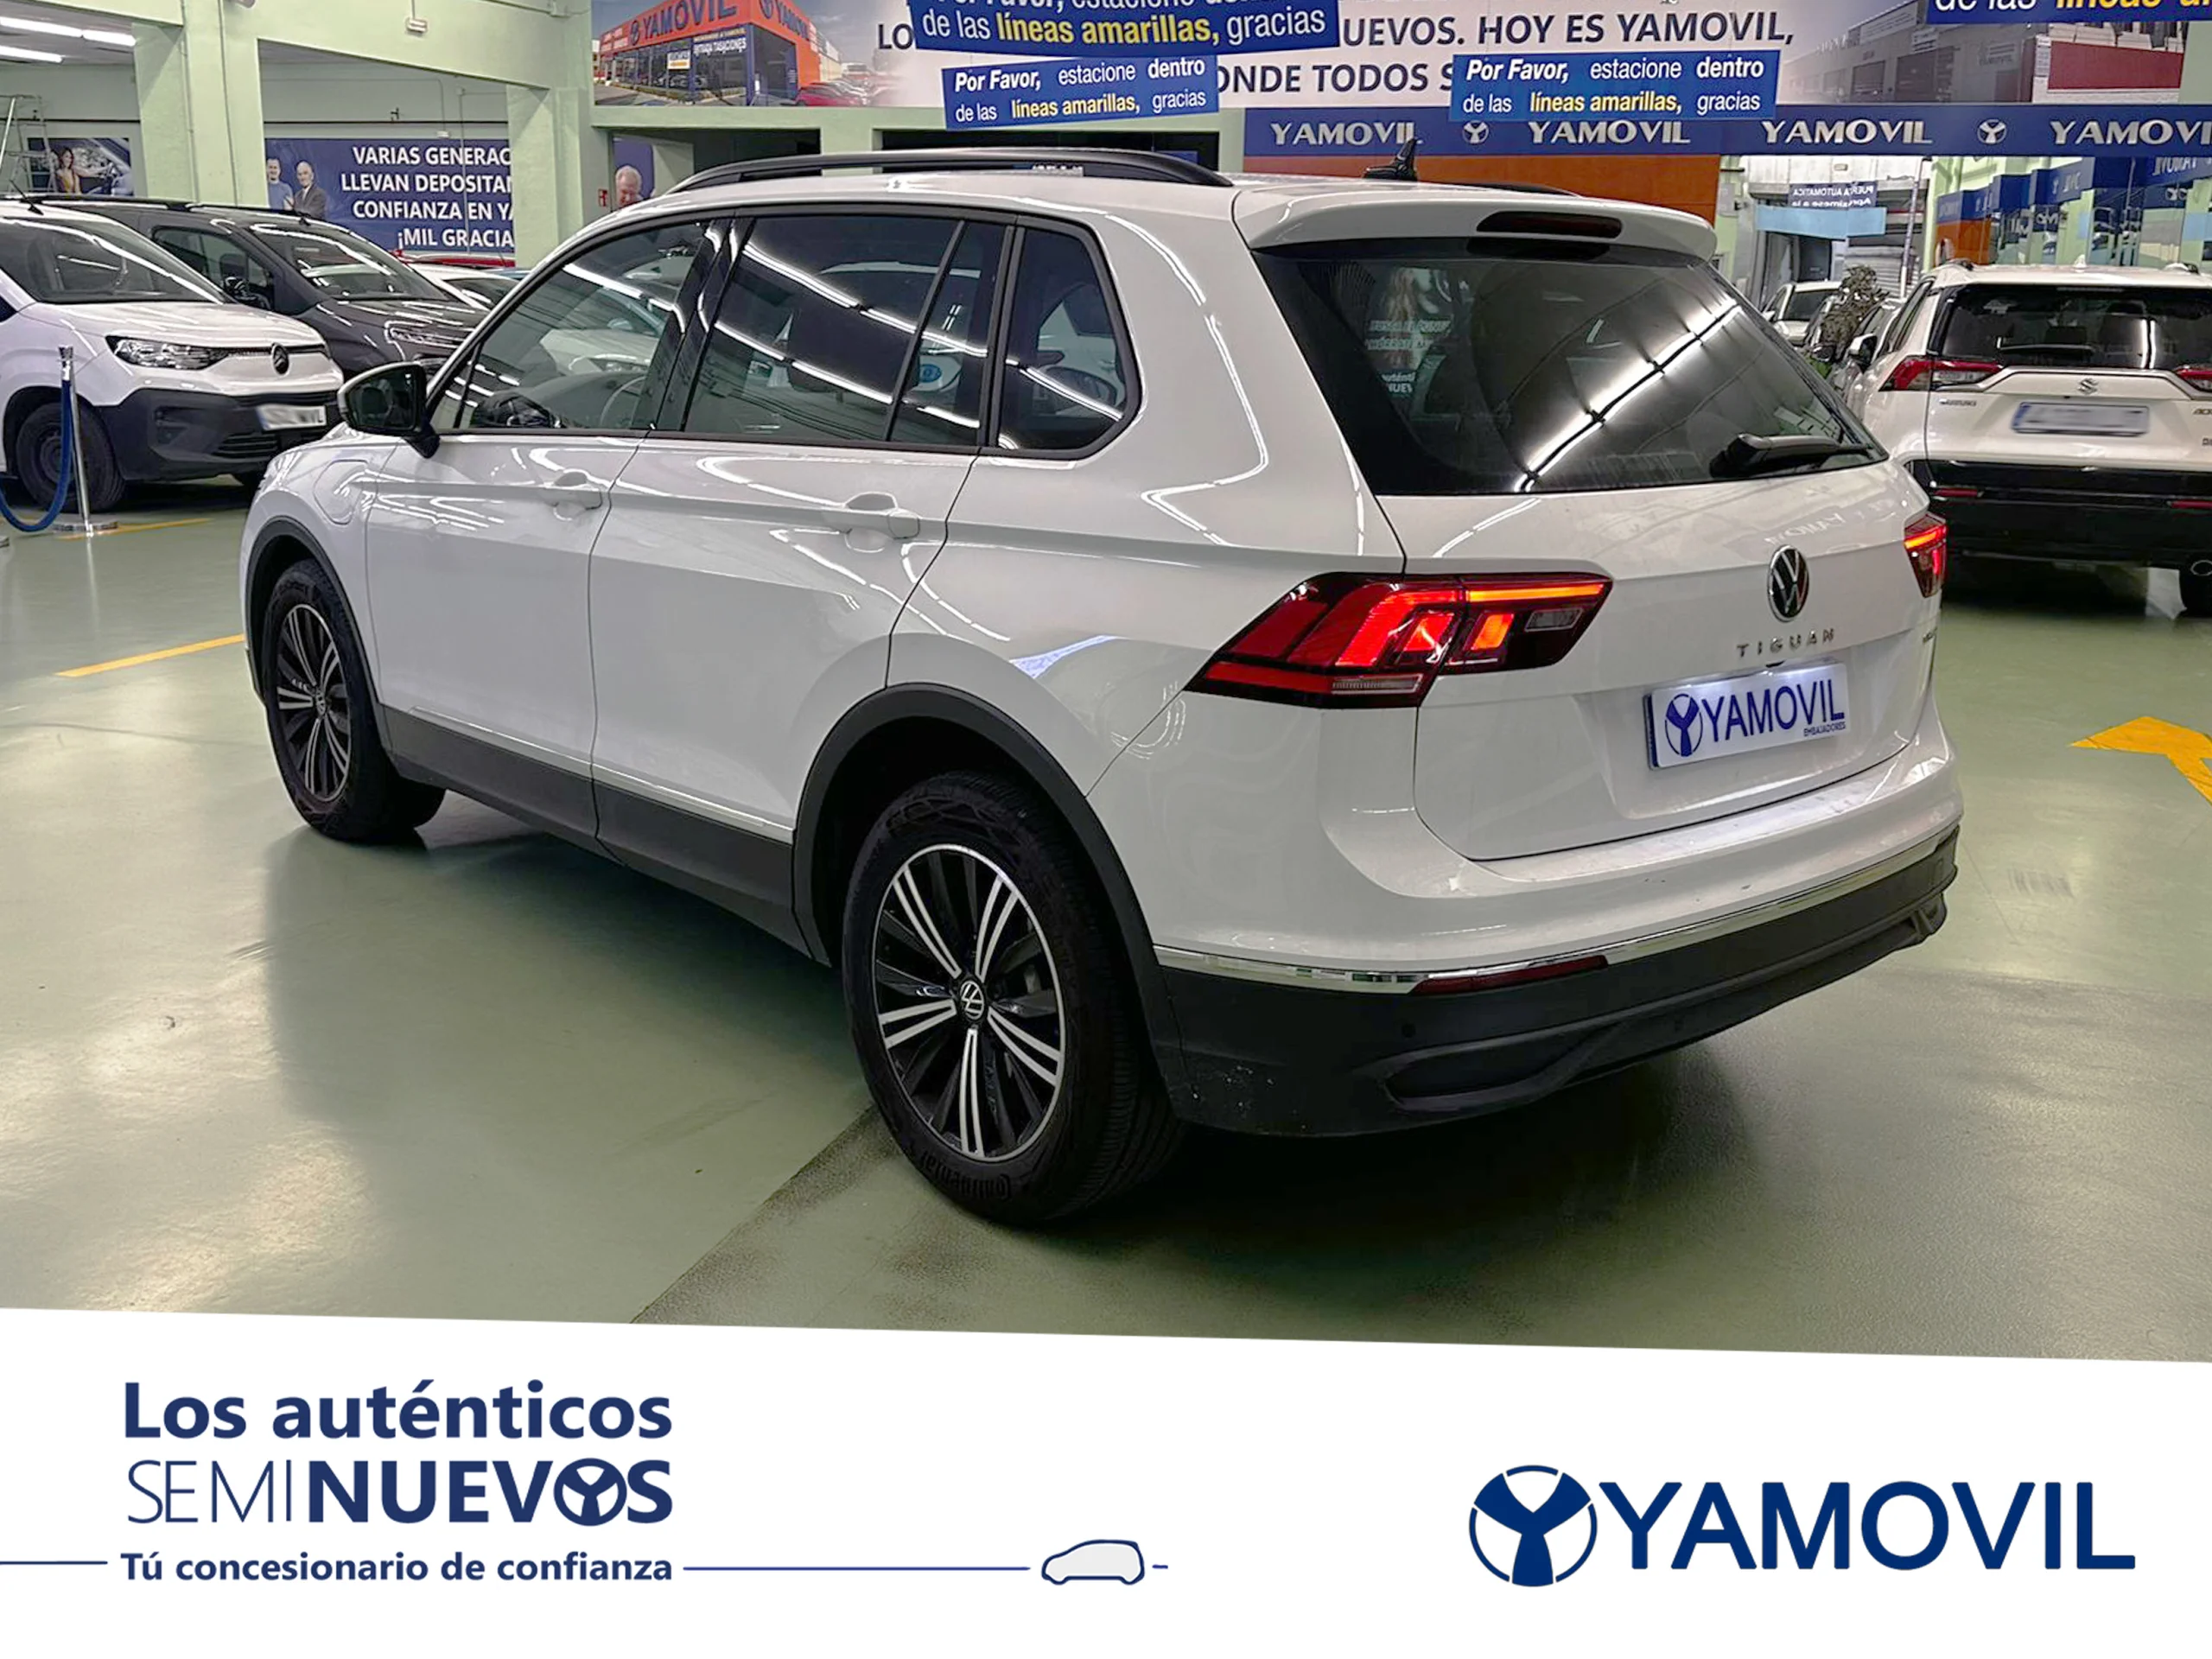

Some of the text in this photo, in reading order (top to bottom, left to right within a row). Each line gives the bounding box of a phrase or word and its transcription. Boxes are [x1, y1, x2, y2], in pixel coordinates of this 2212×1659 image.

[923, 9, 950, 37] de
[956, 10, 990, 40] las
[996, 12, 1074, 43] líneas
[1082, 14, 1219, 45] amarillas,
[1227, 6, 1325, 45] gracias
[1343, 17, 1465, 46] UEVOS.
[1478, 15, 1554, 44] HOY
[1566, 15, 1604, 43] ES
[1618, 12, 1794, 45] YAMOVIL,
[955, 57, 1205, 92] Por Favor, estacione dentro
[1313, 63, 1428, 92] TODOS
[1466, 56, 1764, 84] Por Favor, estacione dentro
[956, 89, 1206, 123] de las líneas amarillas, gracias
[1463, 91, 1760, 116] de las líneas amarillas, gracias
[1271, 123, 1423, 146] YAMOVIL
[1529, 120, 1690, 144] YAMOVIL
[1762, 120, 1933, 145] YAMOVIL
[353, 146, 421, 165] VARIAS
[340, 173, 409, 192] LLEVAN
[353, 200, 463, 219] CONFIANZA
[468, 202, 492, 220] EN
[397, 227, 437, 250] ¡MIL
[1737, 628, 1834, 658] TIGUAN
[1701, 679, 1846, 743] YAMOVIL
